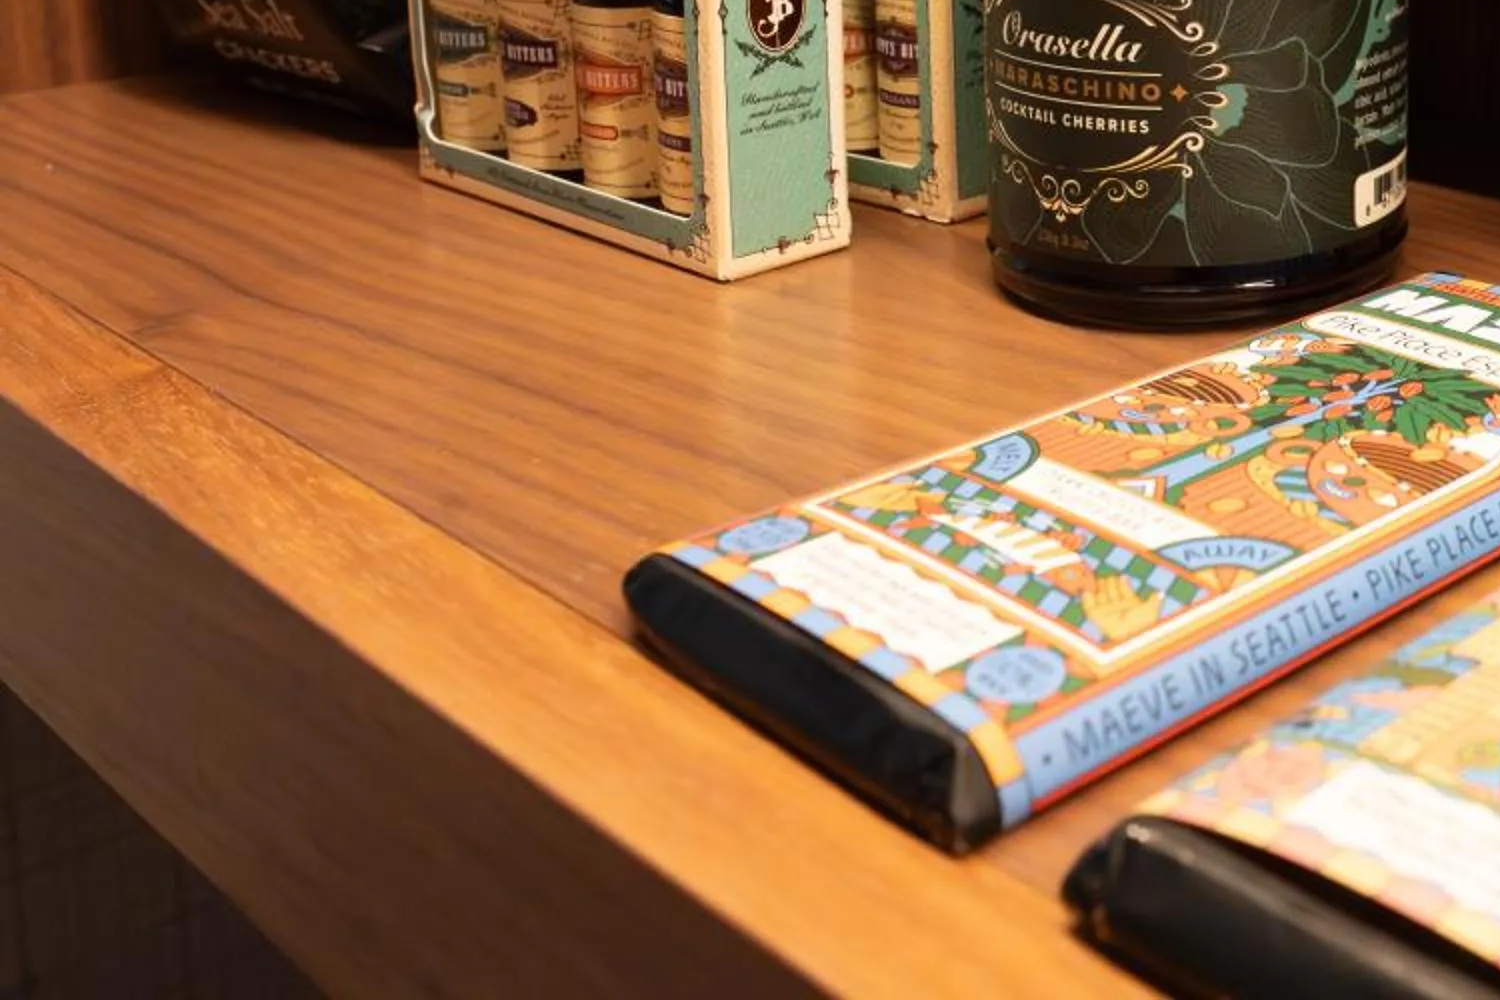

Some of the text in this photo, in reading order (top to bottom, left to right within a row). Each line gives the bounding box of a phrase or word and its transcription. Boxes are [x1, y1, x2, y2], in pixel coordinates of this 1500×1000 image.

[1003, 10, 1144, 63] Orasella
[994, 58, 1162, 101] MARASCHINO
[1001, 97, 1150, 134] COCKTAIL CHERRIES
[1061, 675, 1184, 764] MAEVE
[1189, 660, 1225, 696] IN
[1229, 589, 1347, 676] SEATTLE
[1365, 540, 1428, 601] PIKE
[1426, 508, 1499, 568] PLACE
